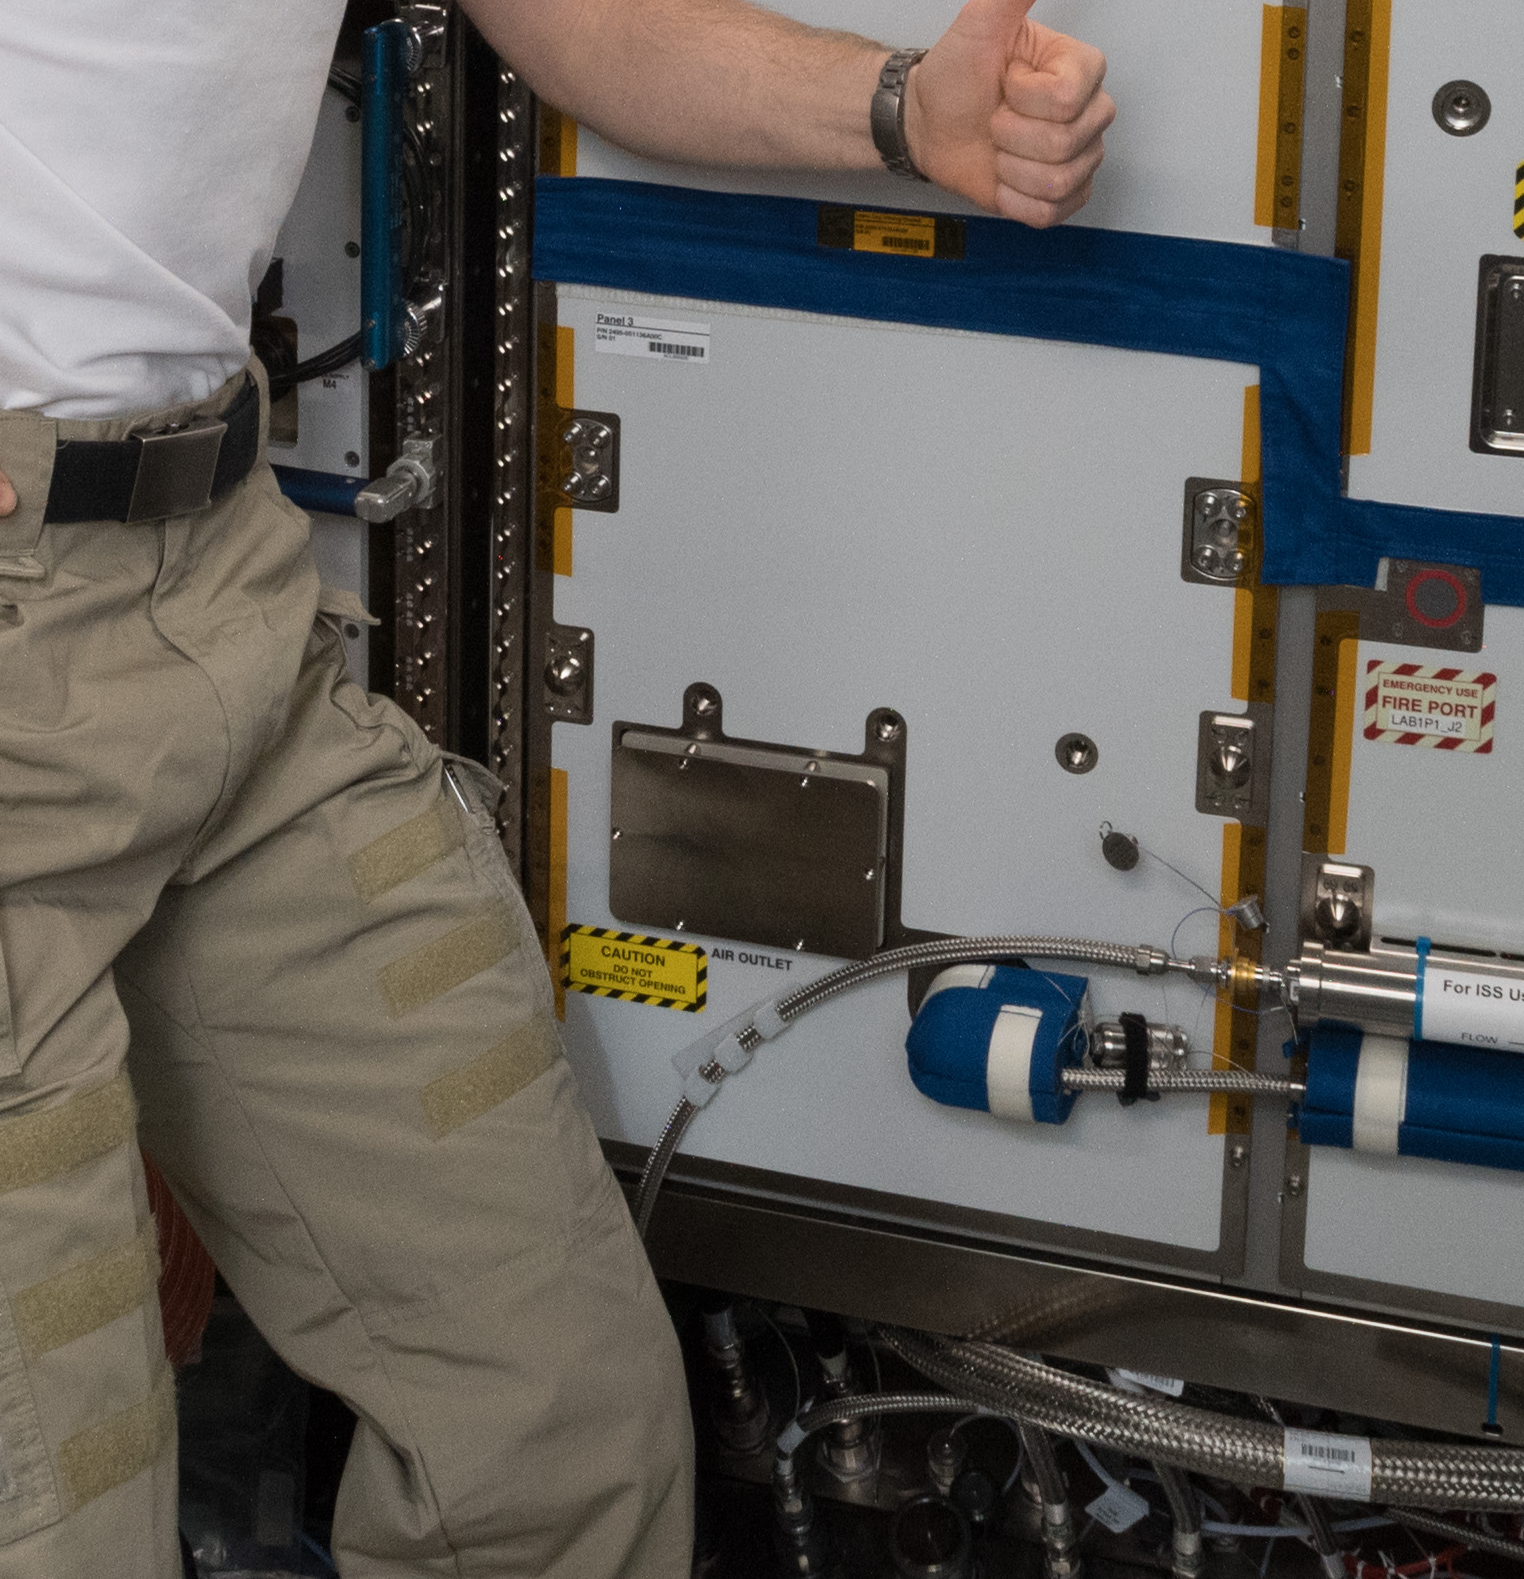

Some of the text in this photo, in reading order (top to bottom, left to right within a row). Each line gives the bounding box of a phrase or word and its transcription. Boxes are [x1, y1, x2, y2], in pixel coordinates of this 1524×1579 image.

[597, 314, 625, 326] Panel
[1383, 679, 1478, 698] EMERGENCY USE
[1382, 695, 1478, 719] FIRE PORT
[1391, 715, 1462, 734] LAB1P1_J2
[601, 945, 666, 967] CAUTION
[711, 948, 792, 971] AIR OUTLET
[613, 964, 652, 978] DO NOT
[580, 968, 686, 995] OBSTRUCT OPENING
[1443, 979, 1471, 996] For
[1476, 984, 1503, 999] ISS
[1461, 1031, 1498, 1044] FLOW
